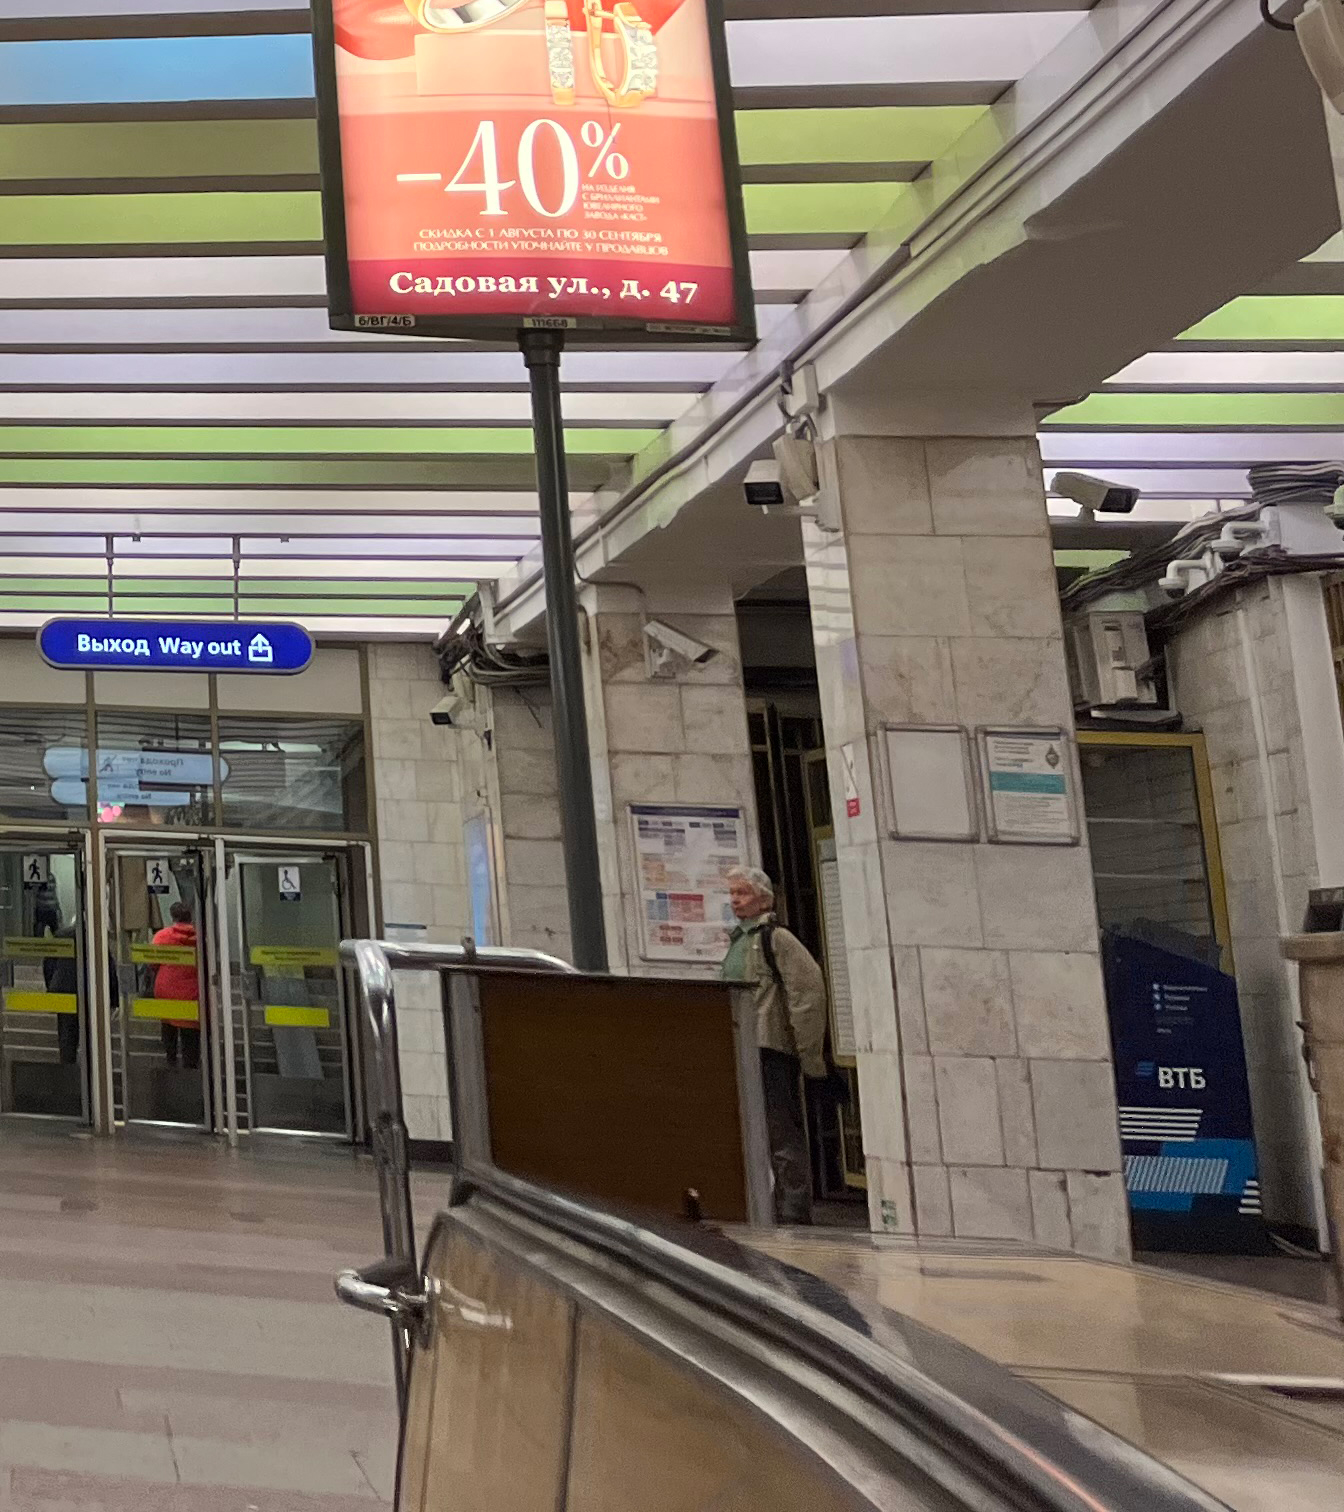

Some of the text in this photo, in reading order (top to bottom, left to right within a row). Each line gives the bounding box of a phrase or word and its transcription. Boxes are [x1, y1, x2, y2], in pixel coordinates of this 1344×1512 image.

[414, 240, 509, 252] ПОДРОБНОСТИ
[419, 228, 473, 239] СКИДКА
[475, 228, 485, 239] С
[499, 228, 554, 239] АВГУСТА
[557, 228, 579, 240] ПО
[582, 229, 597, 240] 30
[599, 230, 662, 243] СЕНТЯБРЯ
[389, 272, 698, 304] Садовая ул., д. 47
[77, 634, 150, 656] Выход
[158, 637, 241, 659] Way out
[1158, 1067, 1206, 1088] ВТБ
